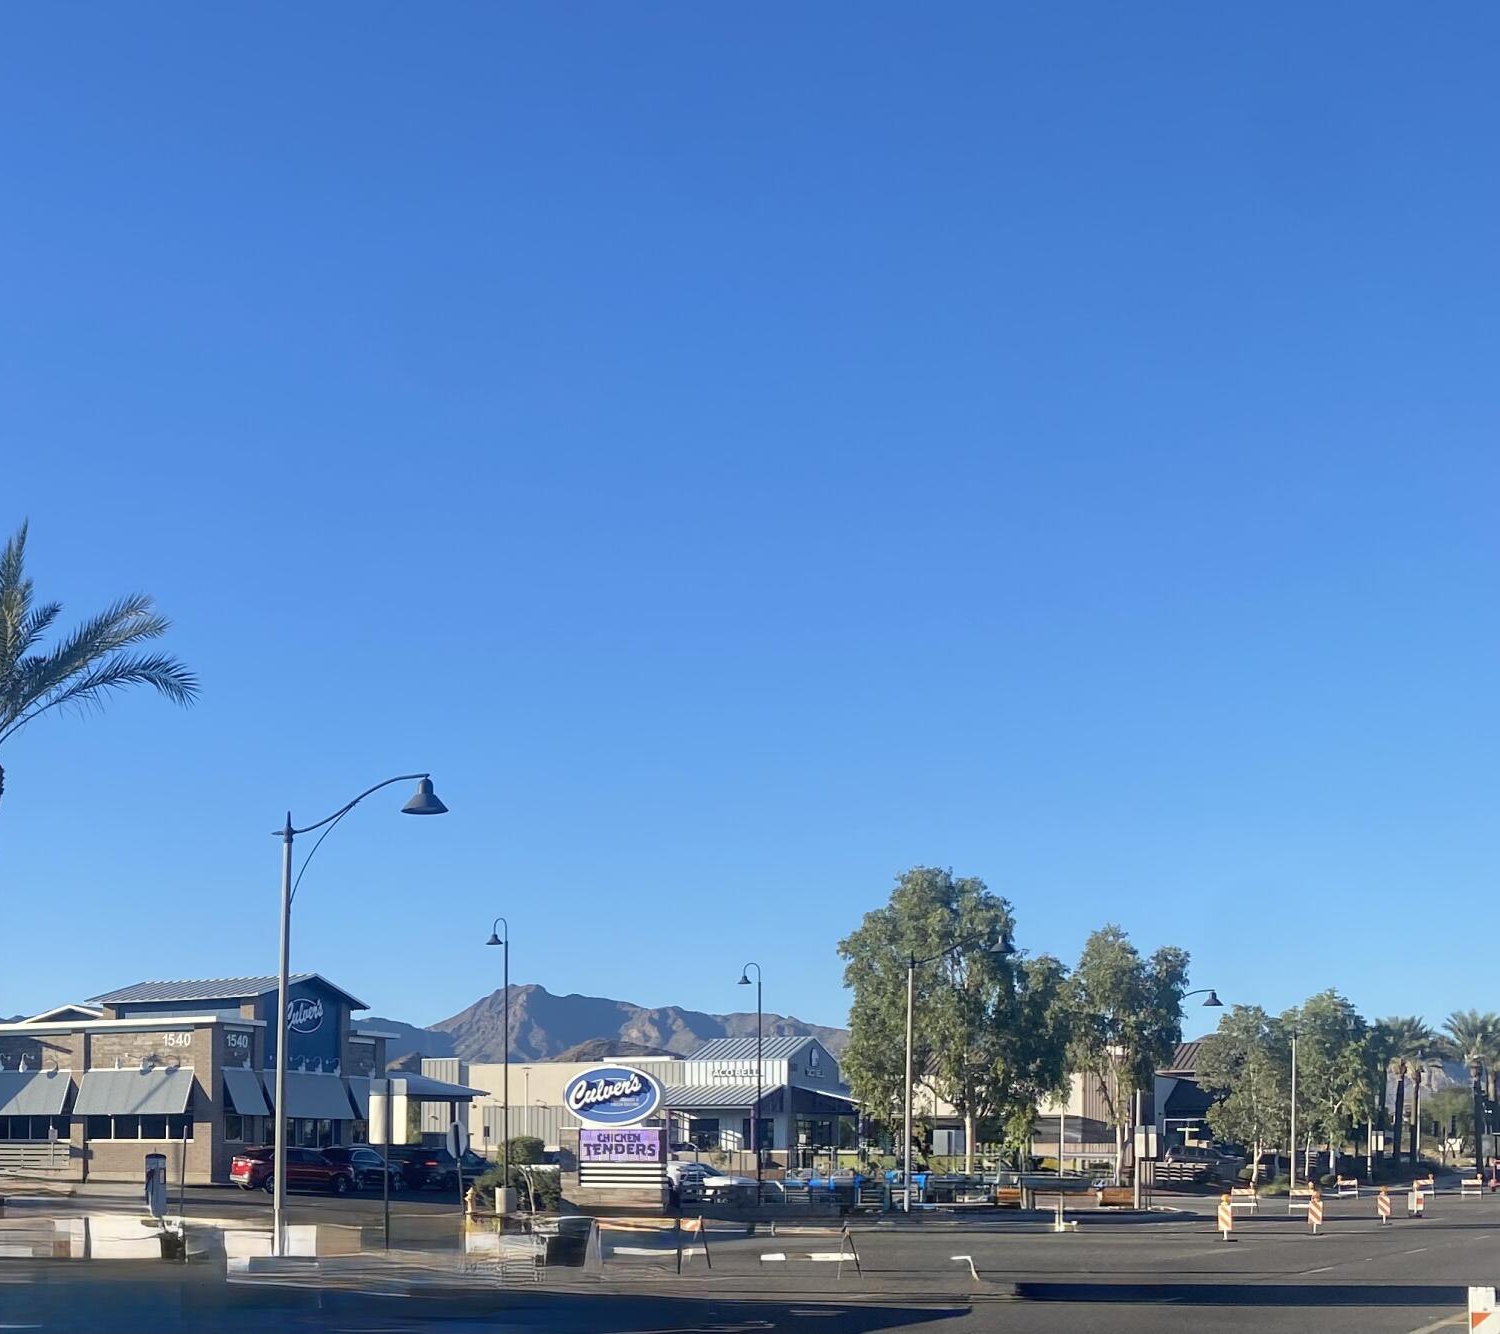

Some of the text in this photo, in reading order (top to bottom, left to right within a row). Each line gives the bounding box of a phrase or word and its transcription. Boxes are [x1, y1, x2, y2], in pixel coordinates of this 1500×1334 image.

[162, 1034, 191, 1046] 1540
[226, 1034, 249, 1048] 1540
[569, 1073, 642, 1110] Culver's
[597, 1133, 640, 1143] CHICKEN
[583, 1143, 656, 1157] TENDERS
